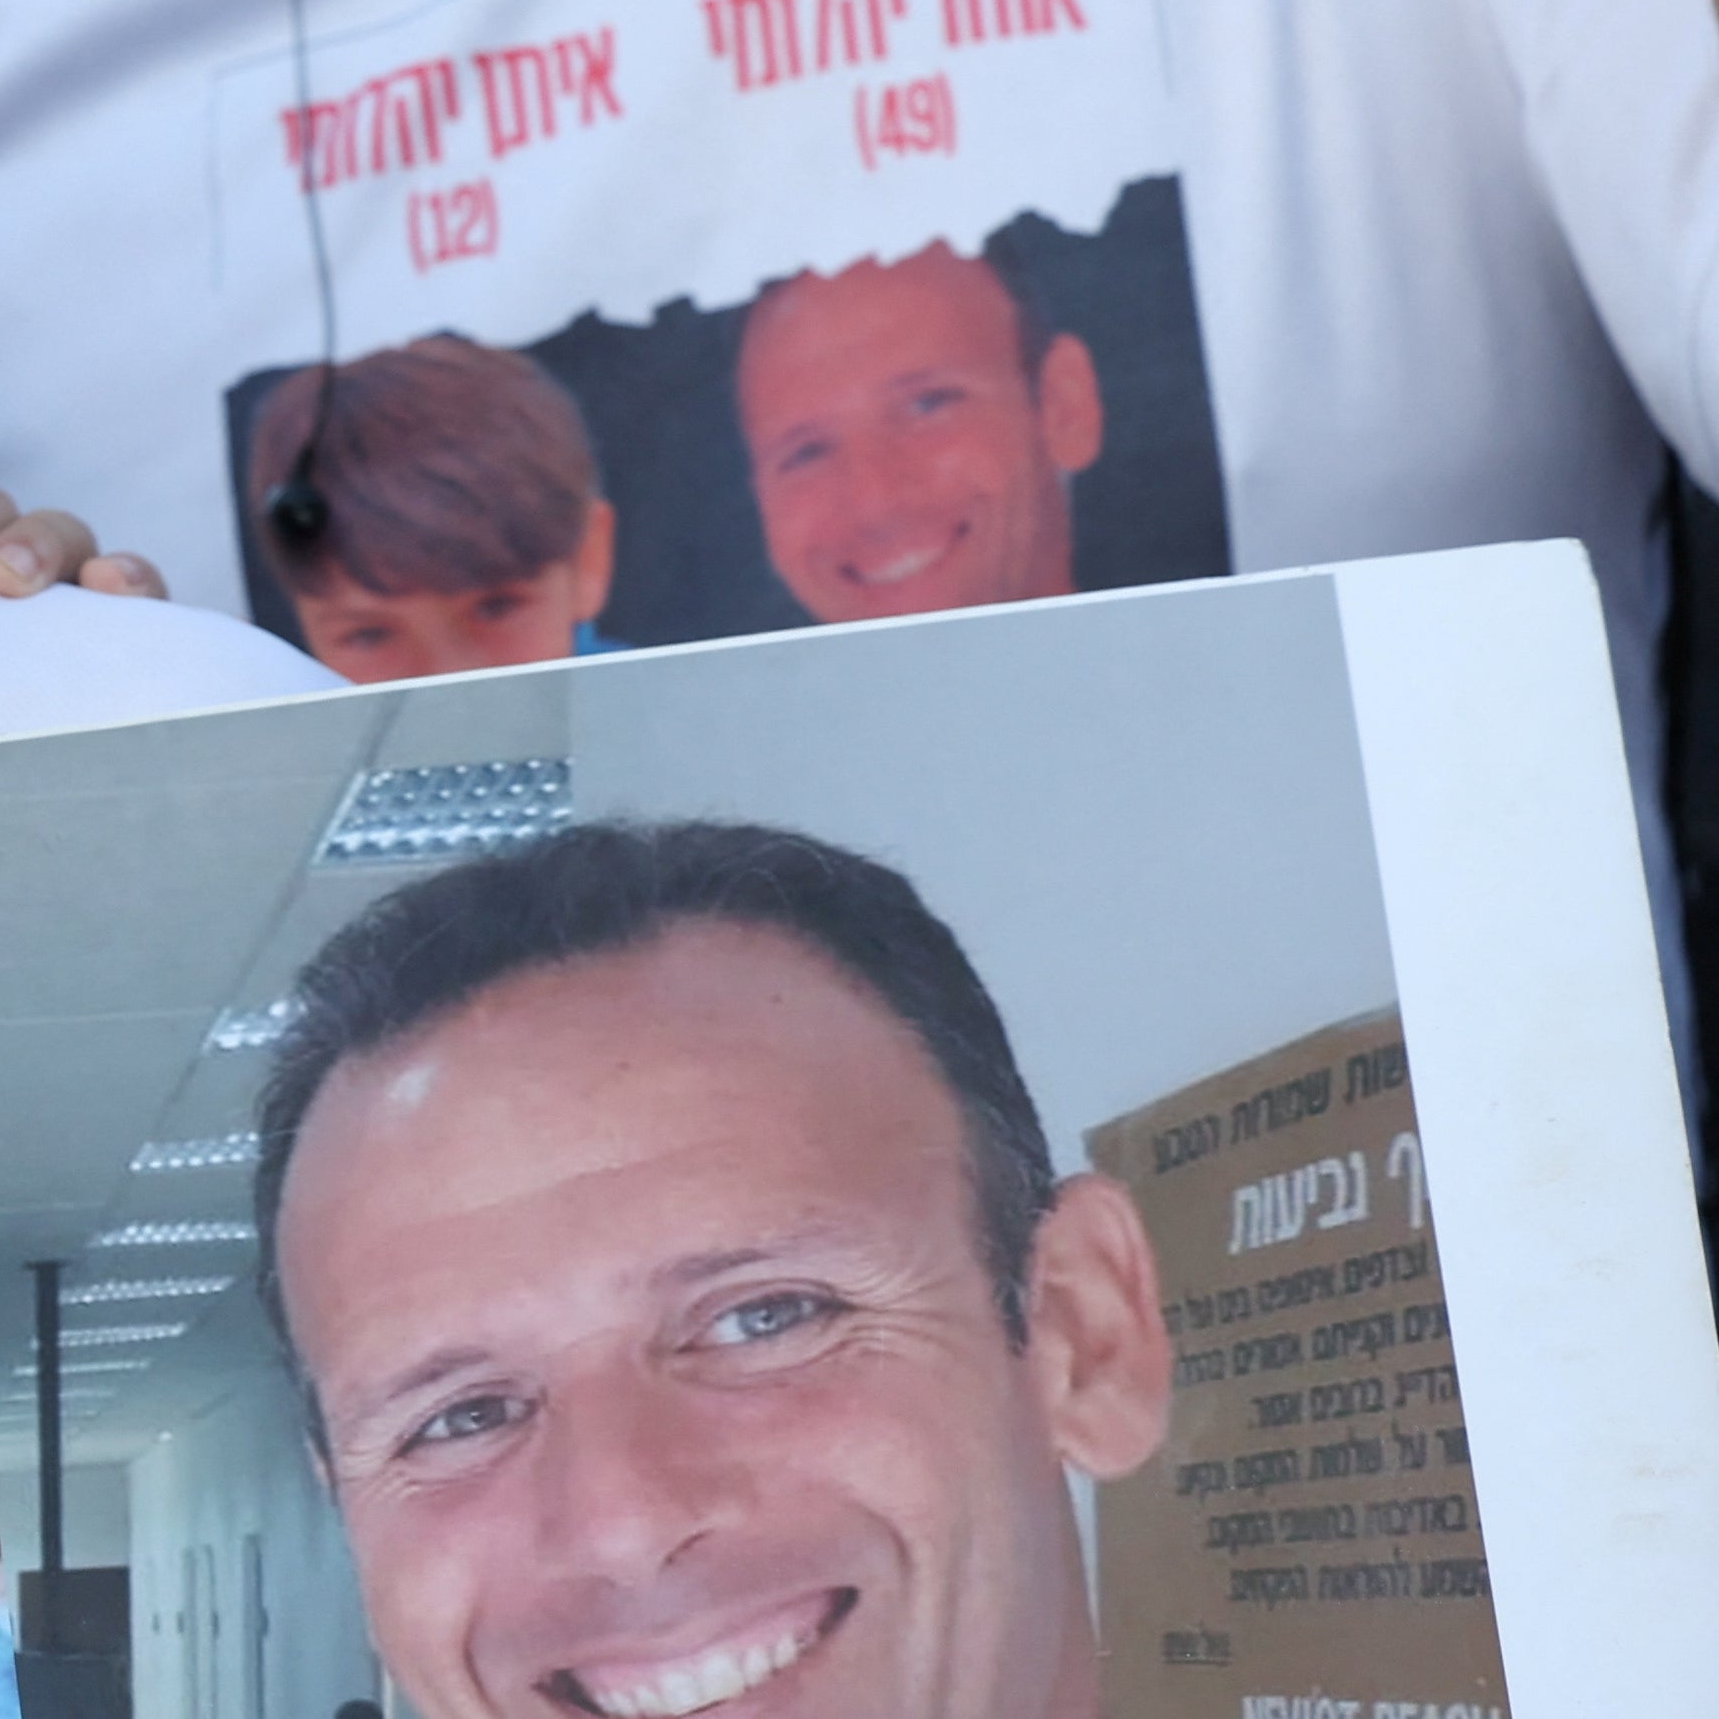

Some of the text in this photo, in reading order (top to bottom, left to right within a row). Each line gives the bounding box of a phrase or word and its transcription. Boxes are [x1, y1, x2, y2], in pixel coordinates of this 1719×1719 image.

[279, 56, 462, 196] יהלומי
[852, 69, 956, 173] (49)
[404, 175, 502, 277] (12)
[1227, 1150, 1370, 1256] נביעות
